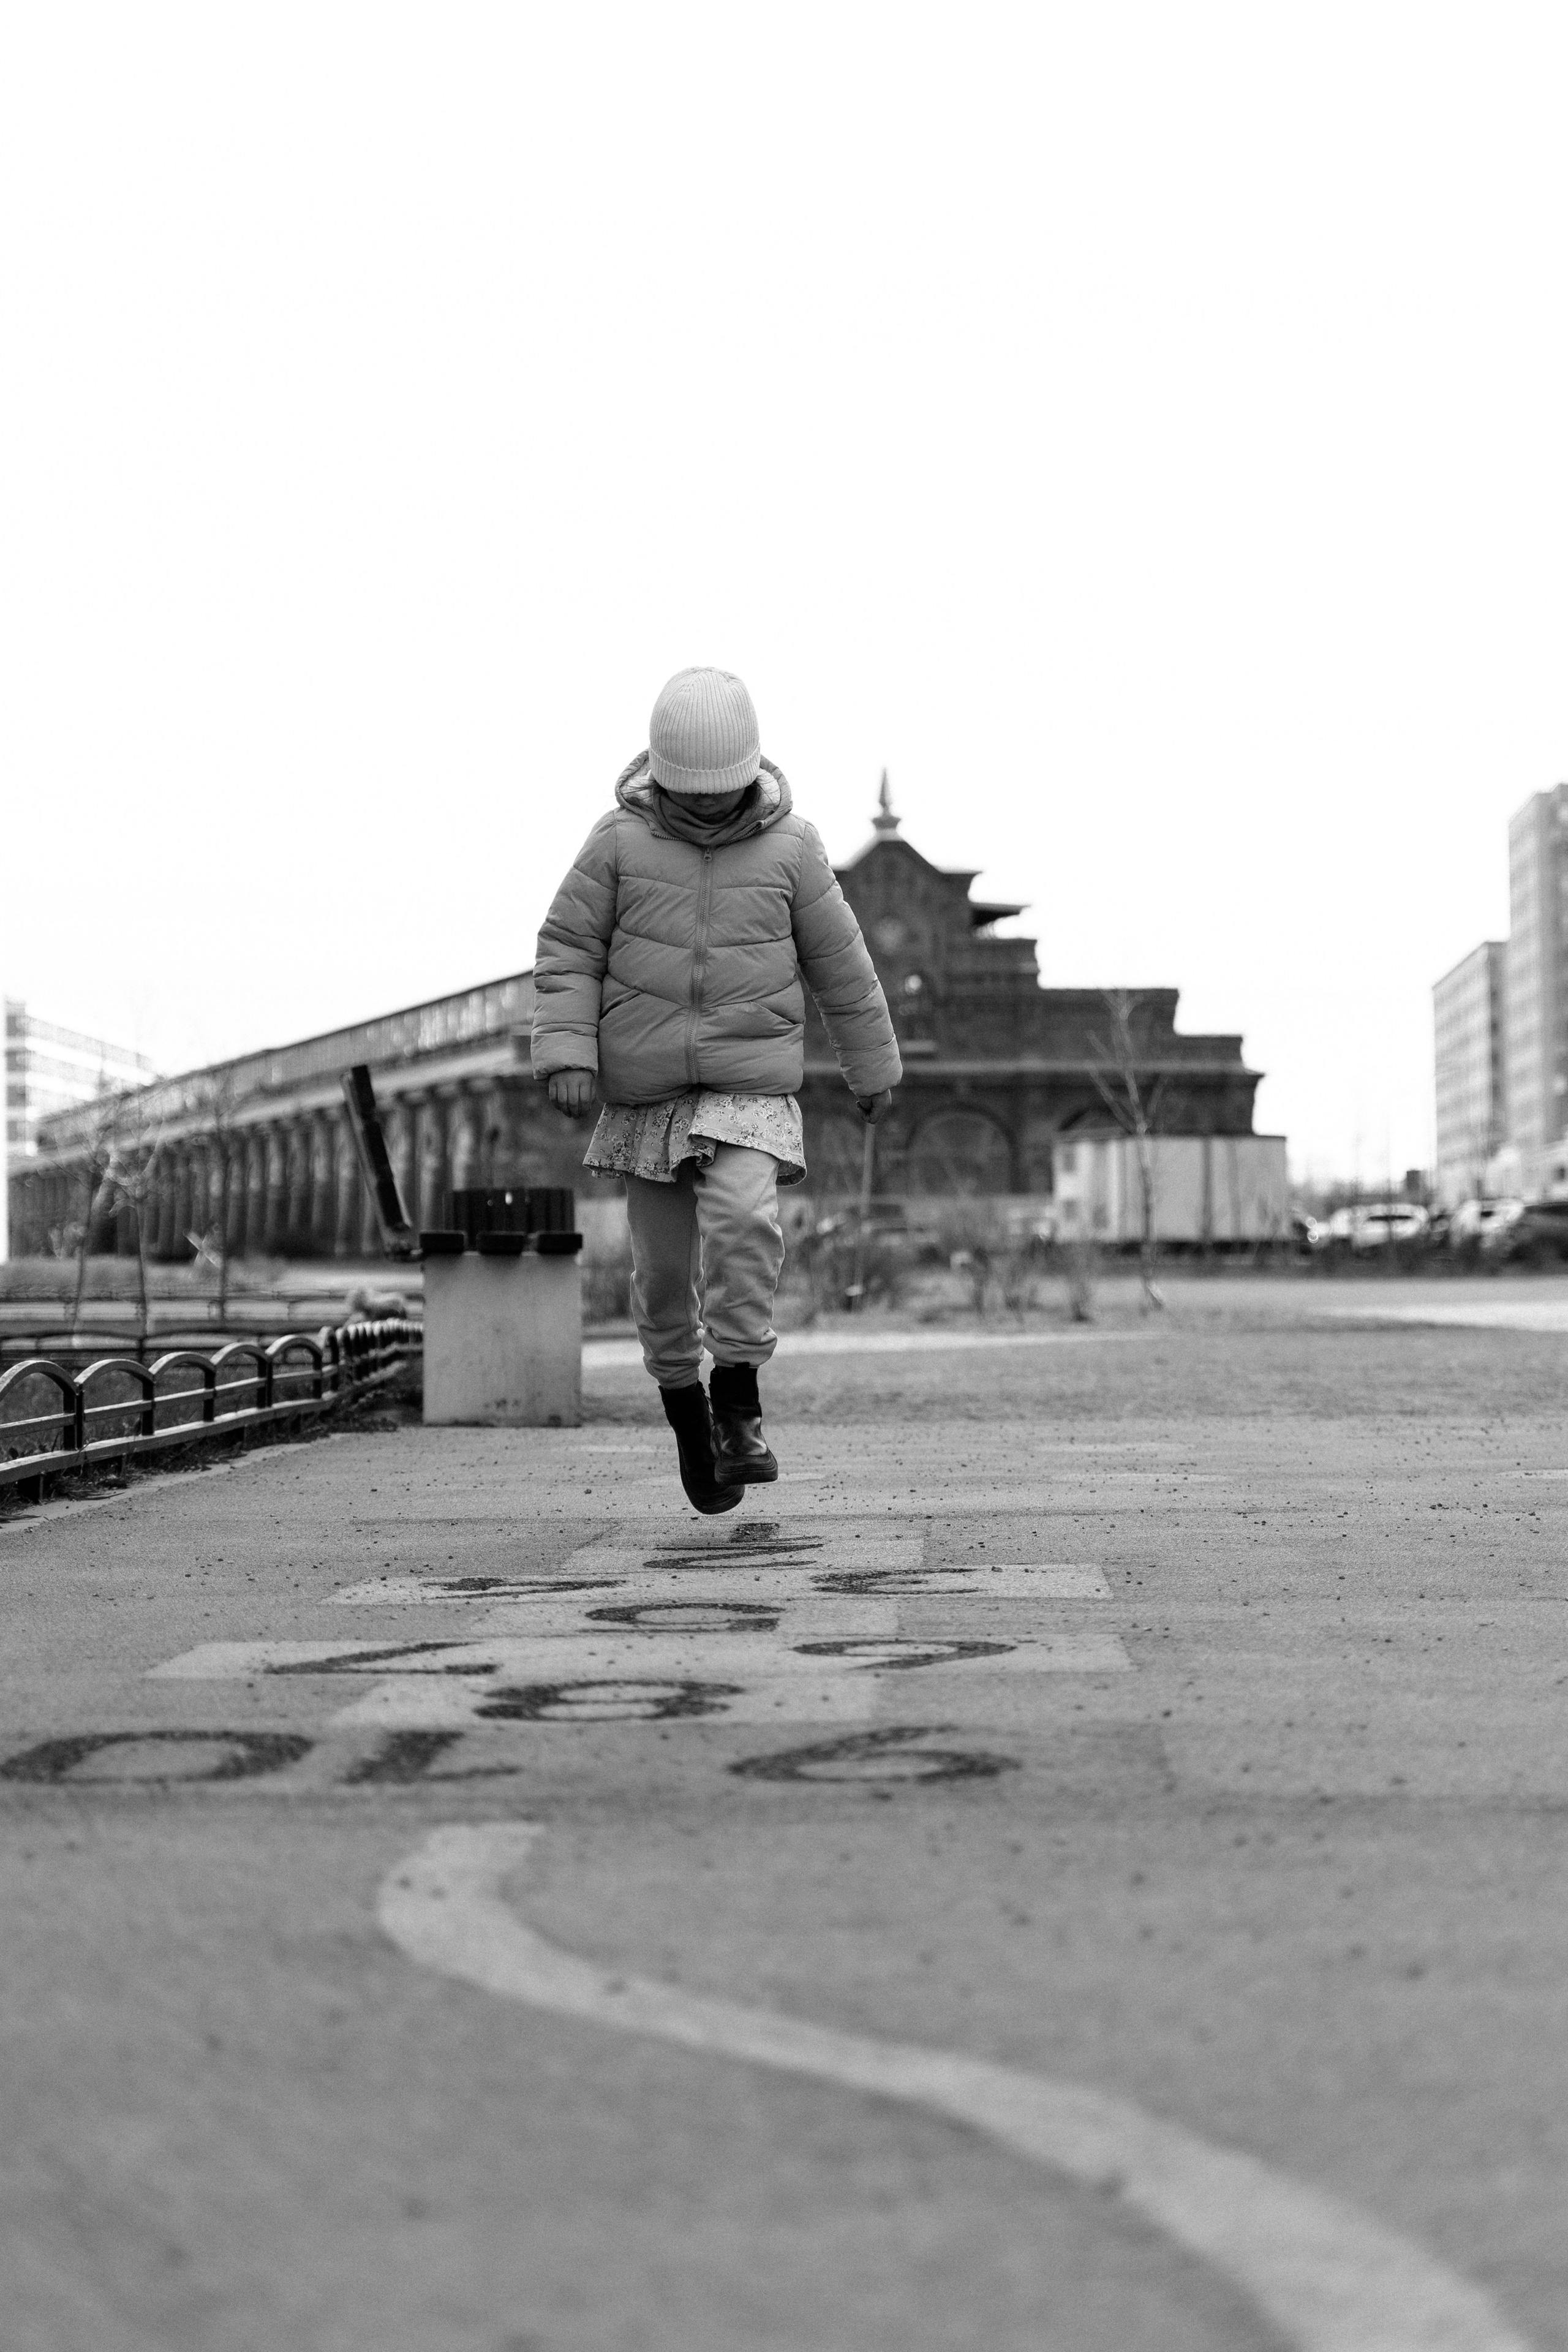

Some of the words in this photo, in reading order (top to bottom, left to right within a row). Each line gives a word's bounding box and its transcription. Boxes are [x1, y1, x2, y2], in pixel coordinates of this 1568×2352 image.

[643, 1544, 824, 1569] 2
[420, 1578, 627, 1599] 4
[810, 1568, 982, 1595] 3
[576, 1603, 786, 1634] 5
[263, 1642, 501, 1675] 7
[472, 1679, 745, 1722] 8
